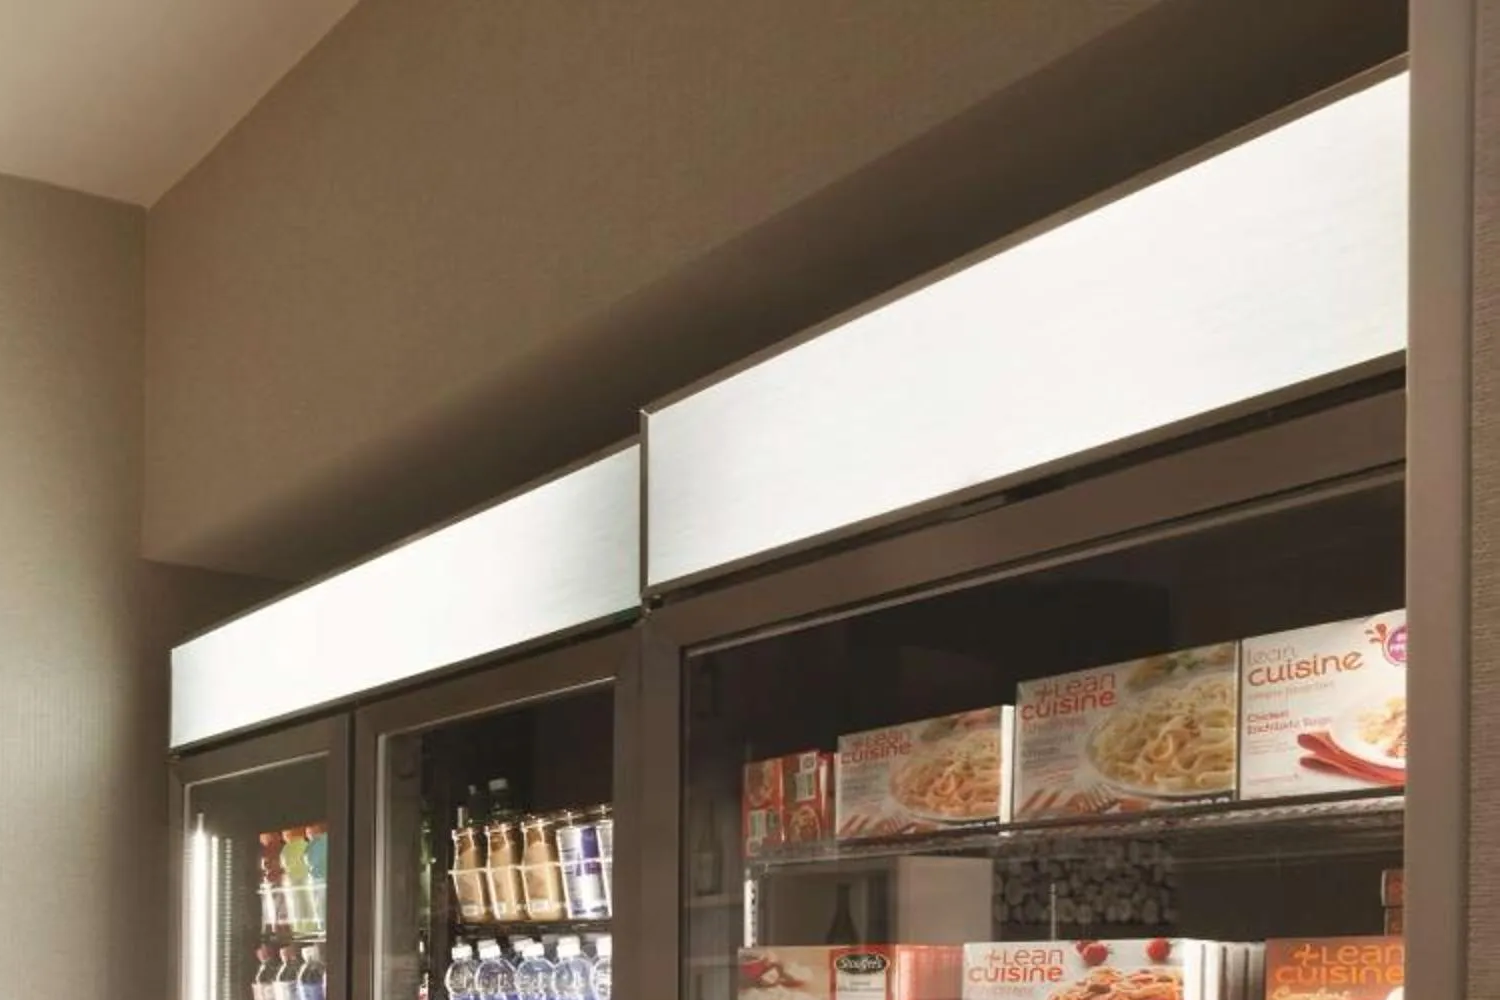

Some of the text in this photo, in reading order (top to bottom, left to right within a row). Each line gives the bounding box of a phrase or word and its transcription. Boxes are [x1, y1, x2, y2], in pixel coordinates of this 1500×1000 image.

[1247, 651, 1364, 687] cuisine
[1021, 690, 1117, 721] cuisine
[968, 965, 1063, 982] cuisine
[1275, 964, 1404, 985] cuisine
